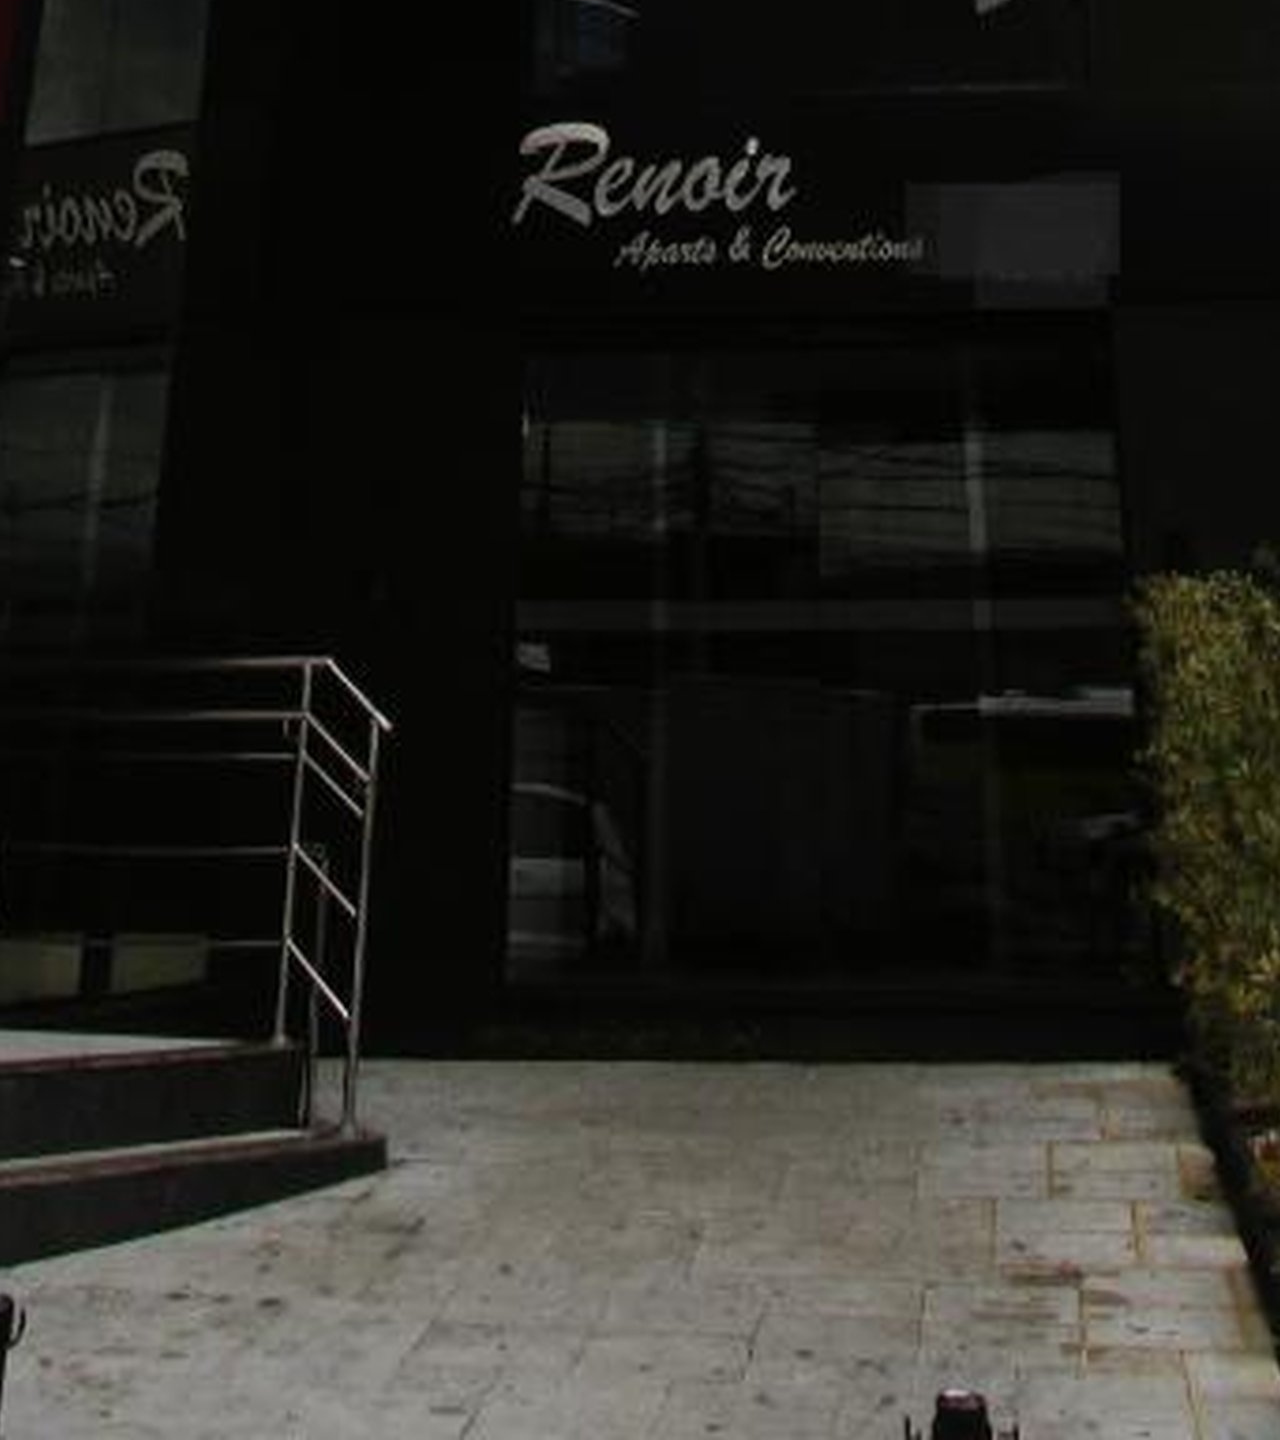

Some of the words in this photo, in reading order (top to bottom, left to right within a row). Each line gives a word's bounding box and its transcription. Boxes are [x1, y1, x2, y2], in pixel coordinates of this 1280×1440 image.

[512, 121, 799, 229] Renoir
[613, 230, 718, 273] Aparts
[727, 226, 752, 263] &
[761, 225, 923, 271] Conventions
